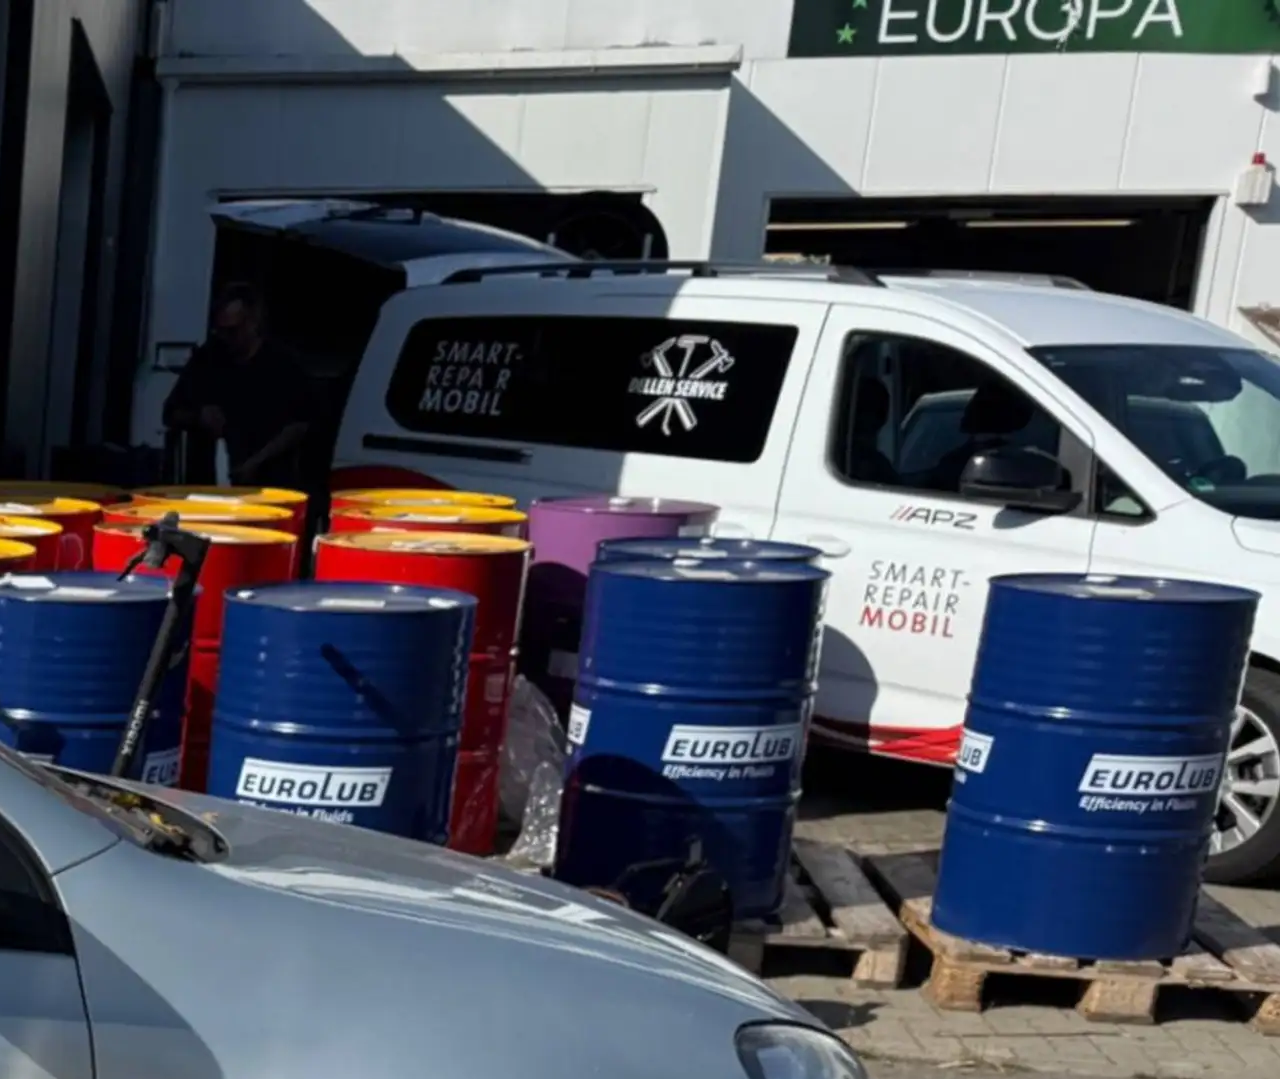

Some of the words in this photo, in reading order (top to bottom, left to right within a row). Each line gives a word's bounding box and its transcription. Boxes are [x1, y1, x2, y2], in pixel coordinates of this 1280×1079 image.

[877, 0, 1184, 45] EUROPA
[419, 387, 502, 417] MOBIL
[868, 560, 972, 590] SMART-
[864, 583, 960, 615] REPAIR
[860, 605, 954, 638] MOBIL
[1078, 796, 1148, 815] Efficiency
